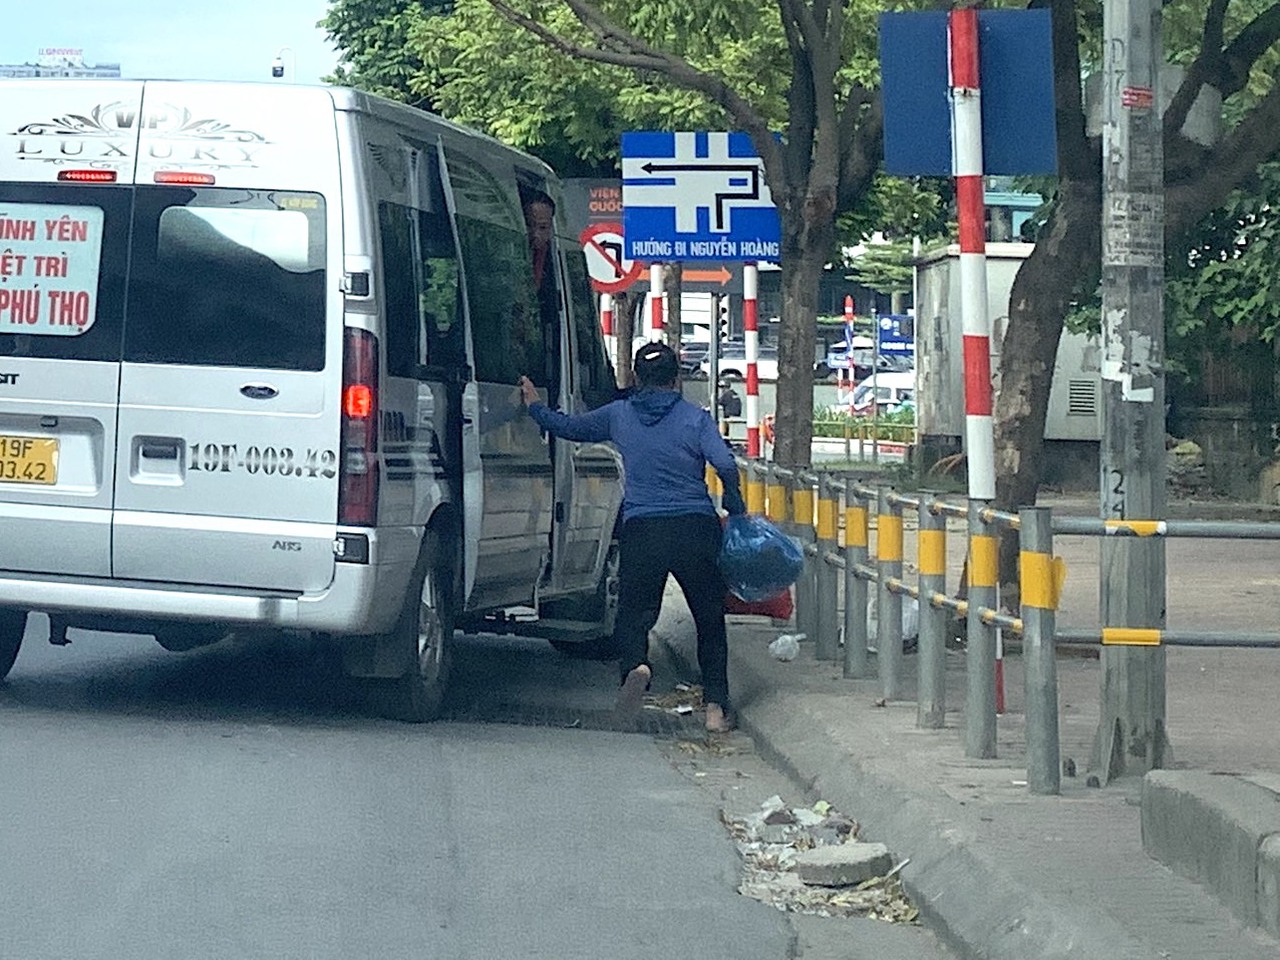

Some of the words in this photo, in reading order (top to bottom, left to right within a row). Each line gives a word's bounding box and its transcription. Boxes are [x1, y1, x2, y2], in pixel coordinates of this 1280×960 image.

[115, 111, 168, 129] VIP
[15, 139, 261, 162] LUXURY
[45, 214, 88, 242] YÊN
[675, 241, 687, 256] ĐI
[690, 236, 737, 257] NGUYỄN
[740, 238, 780, 257] HOÀNG
[34, 251, 68, 278] TRÌ
[48, 290, 90, 333] THỌ
[0, 439, 34, 458] 19F
[188, 443, 336, 479] 19F-003.42
